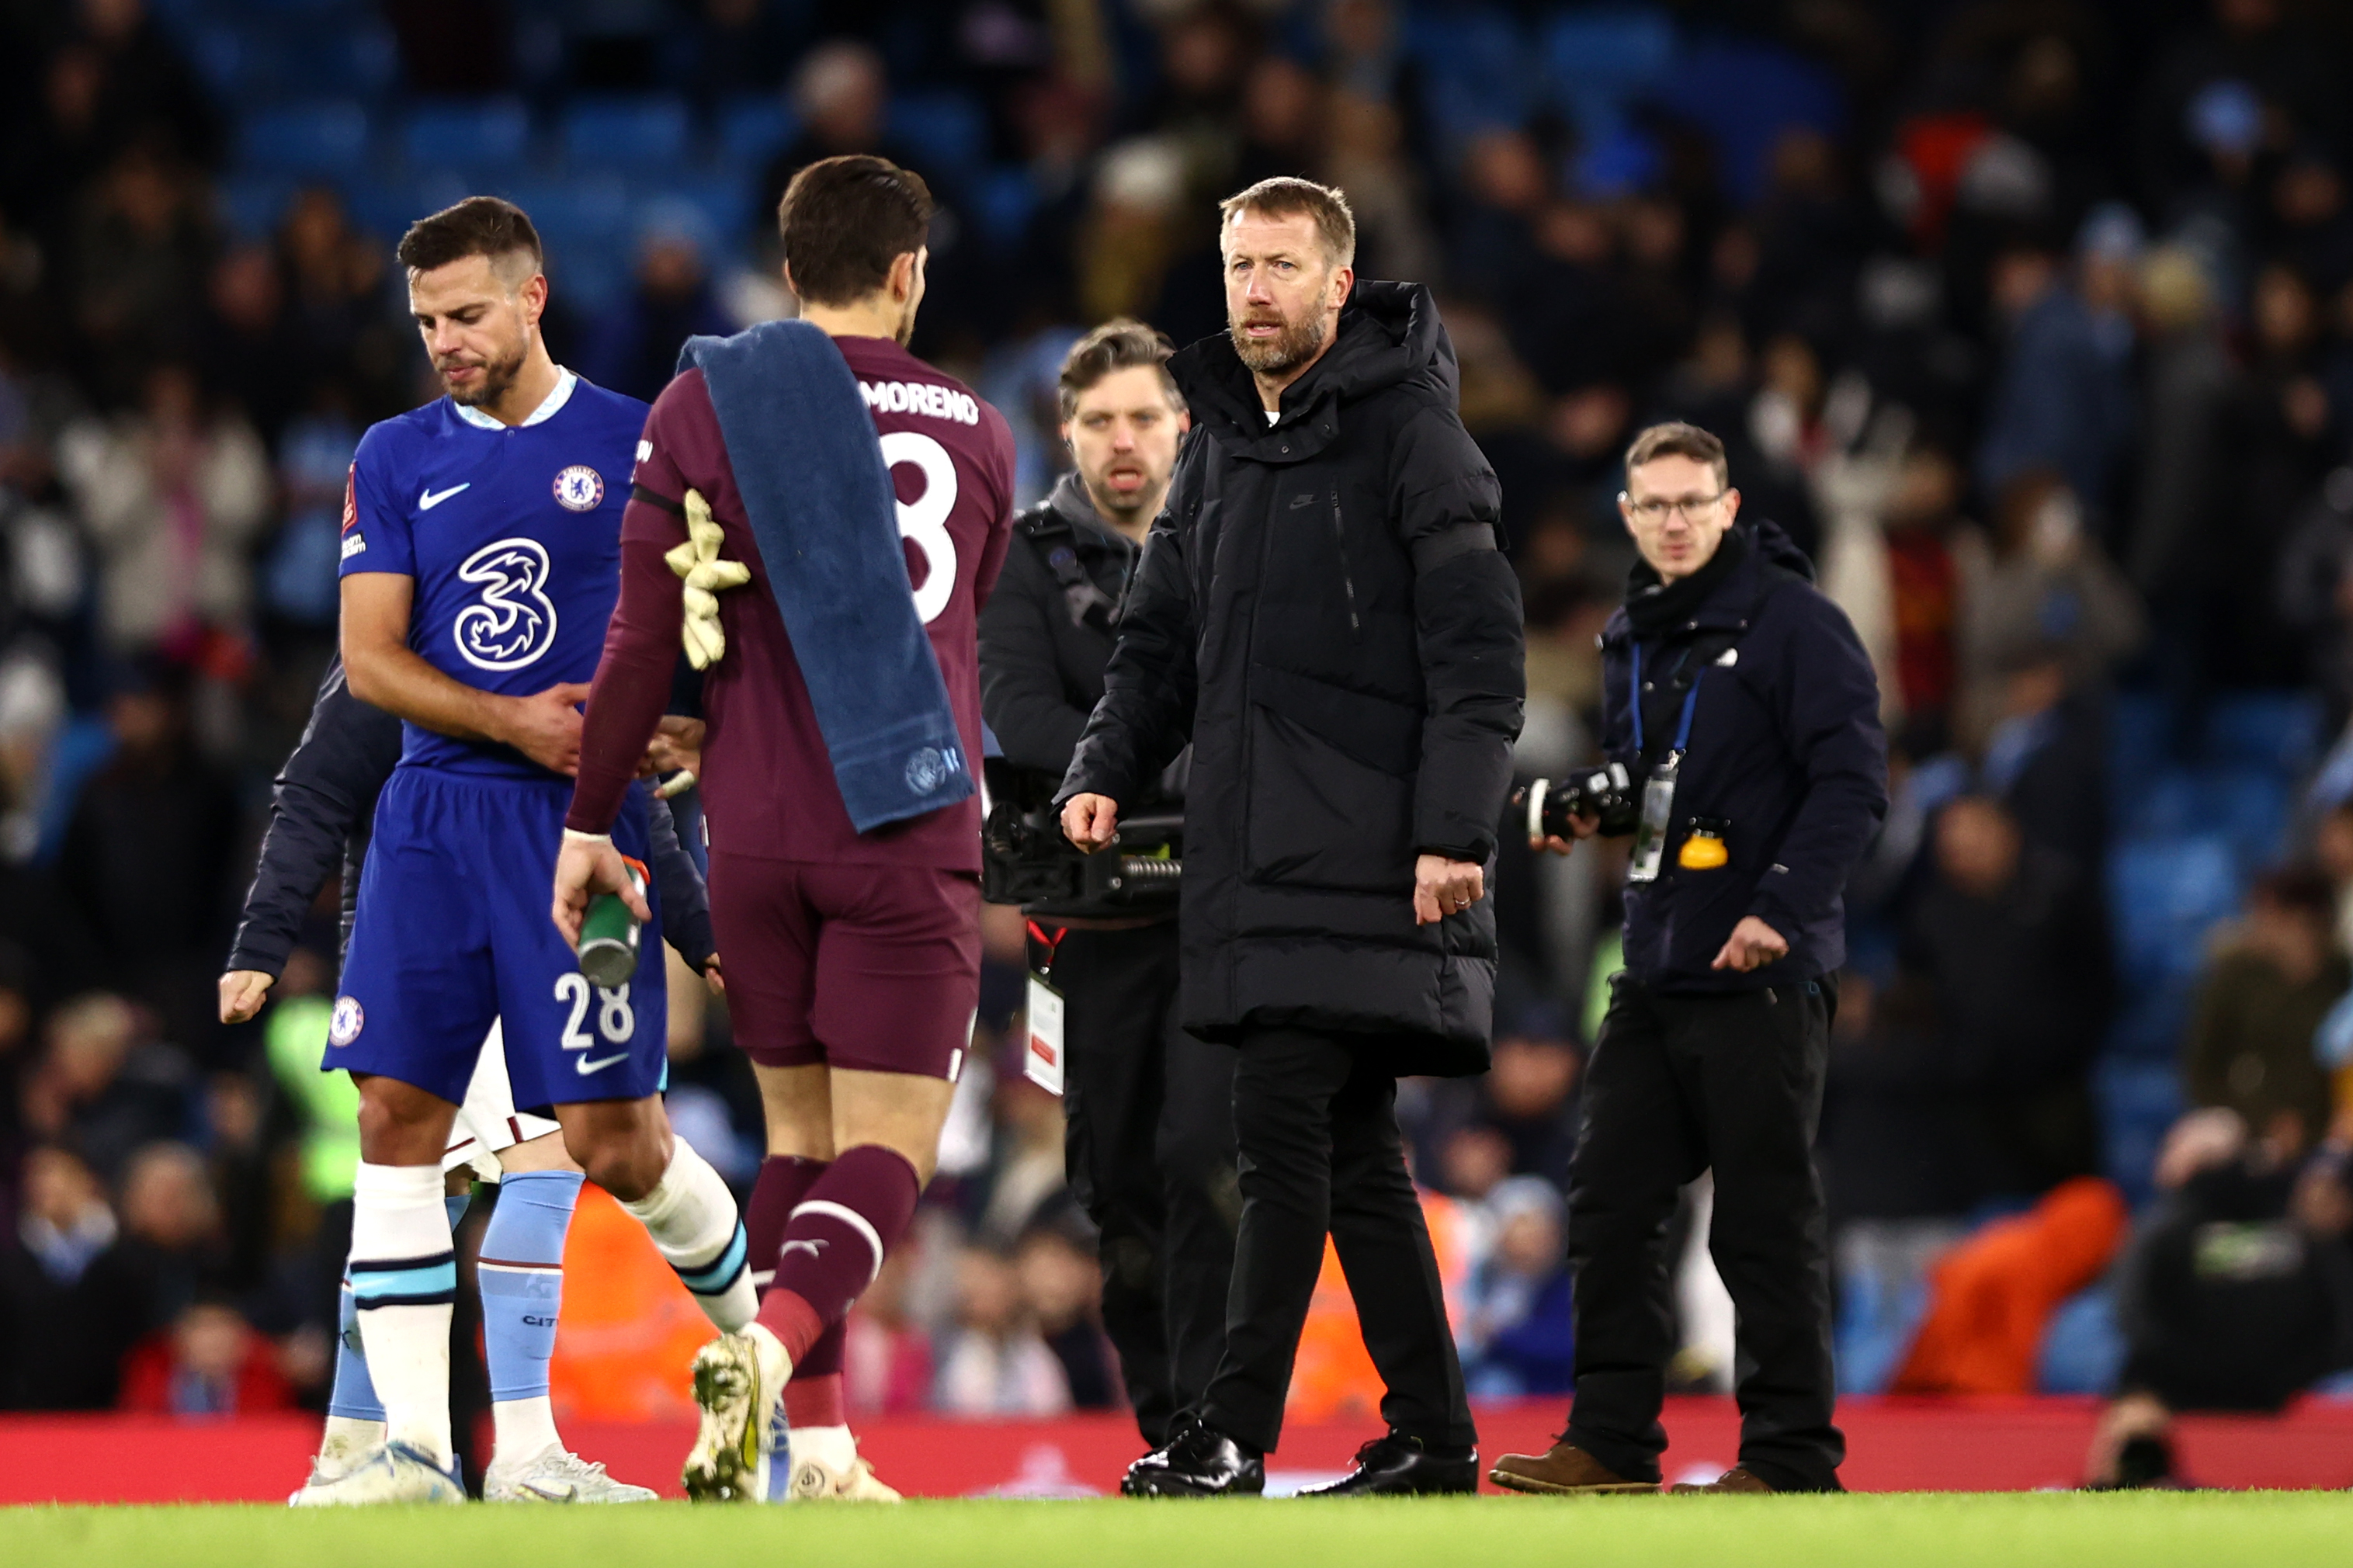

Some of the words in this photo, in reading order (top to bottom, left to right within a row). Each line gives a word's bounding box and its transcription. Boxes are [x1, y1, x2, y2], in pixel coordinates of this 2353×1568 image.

[858, 381, 979, 425] MORENO
[454, 538, 557, 671] 3
[554, 973, 635, 1050] 28
